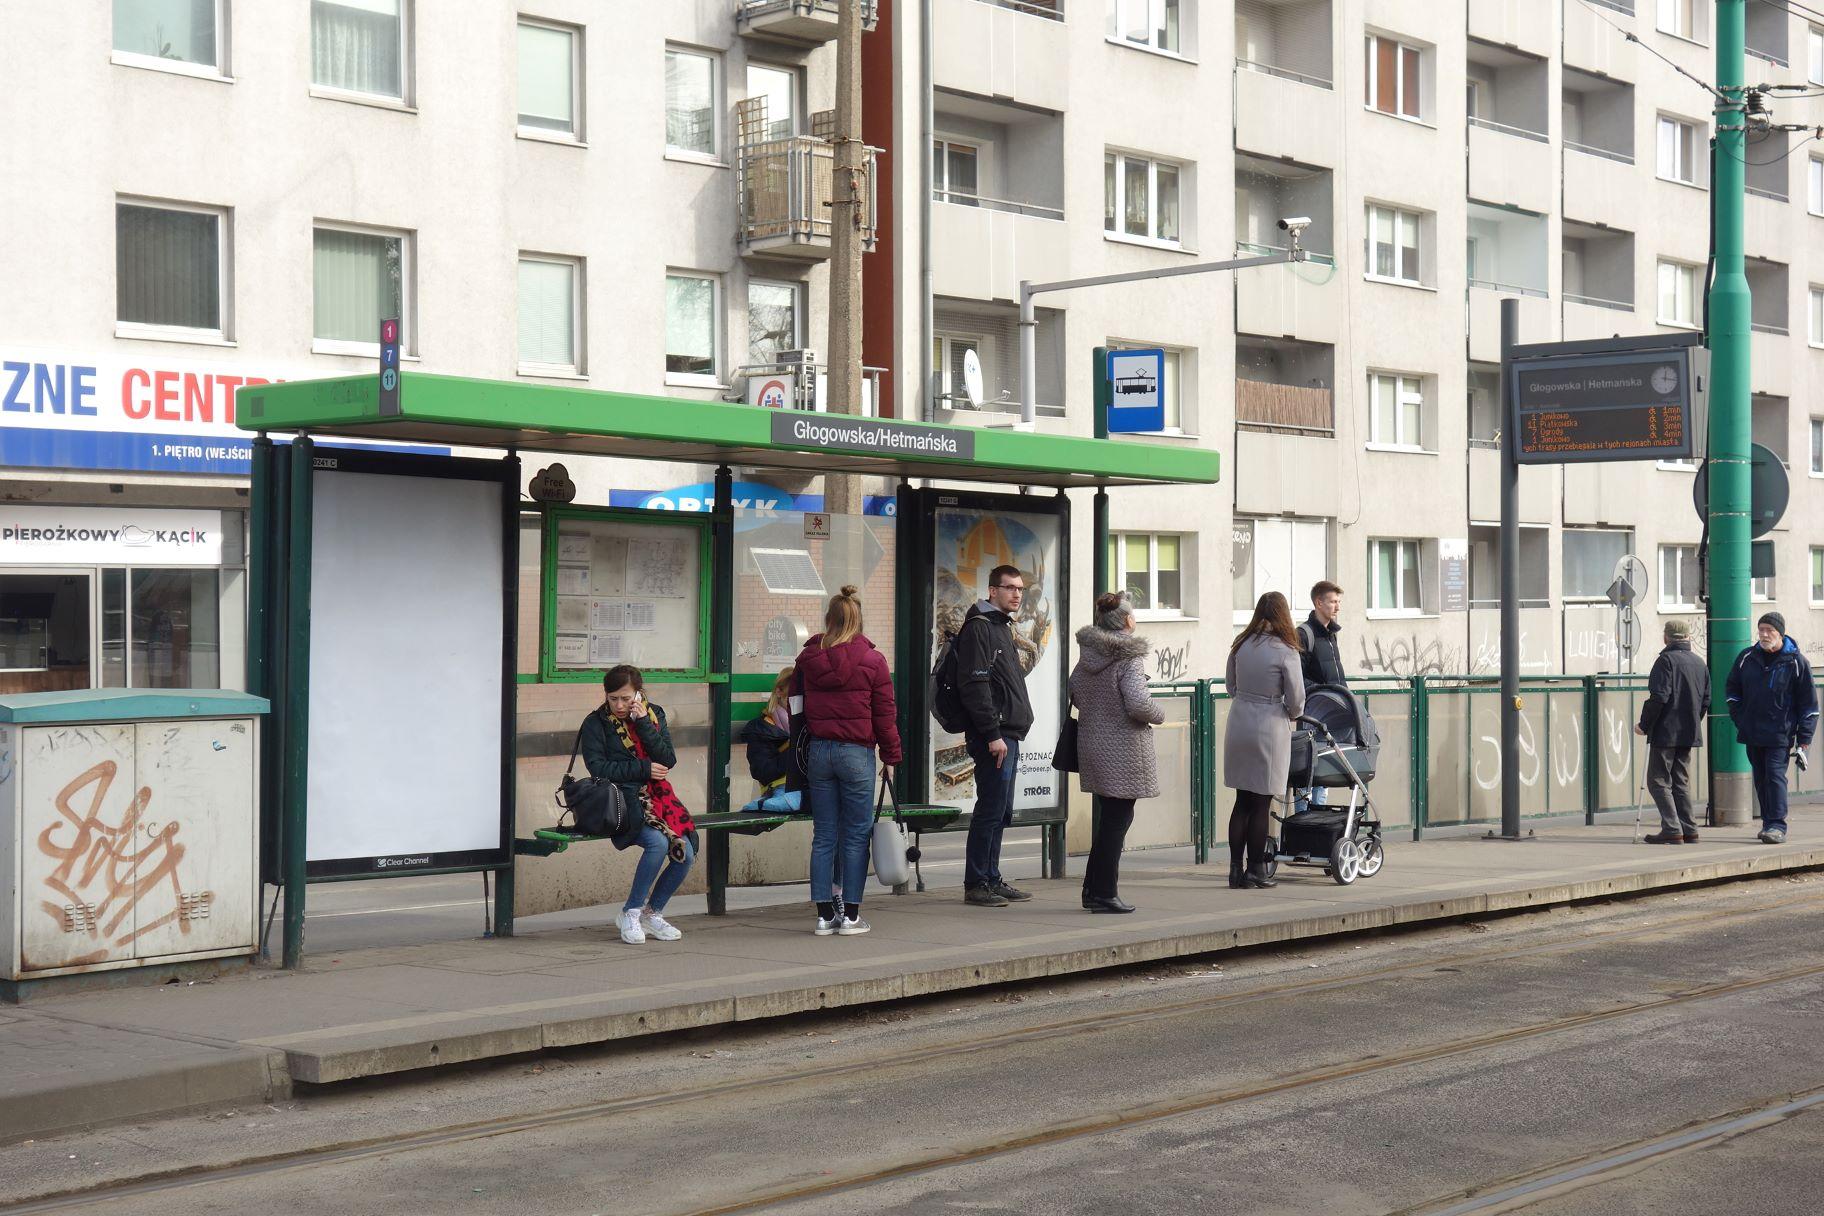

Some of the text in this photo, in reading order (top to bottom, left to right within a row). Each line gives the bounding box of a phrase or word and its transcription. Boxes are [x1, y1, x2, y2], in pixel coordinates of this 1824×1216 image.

[387, 329, 392, 338] 1
[387, 350, 393, 361] 7
[385, 374, 394, 385] 11
[2, 360, 280, 424] ZNE CENT
[794, 420, 957, 452] Głogowska/Hetmańska
[152, 445, 161, 457] 1.
[165, 446, 201, 461] PIĘTRO
[544, 477, 564, 487] Free
[3, 524, 206, 546] PIEROŻKOWY KĄCIK
[768, 629, 786, 640] bike
[1025, 751, 1053, 761] POZNAĆ
[1023, 785, 1051, 796] STRÖER
[386, 856, 429, 866] Clear Channel
